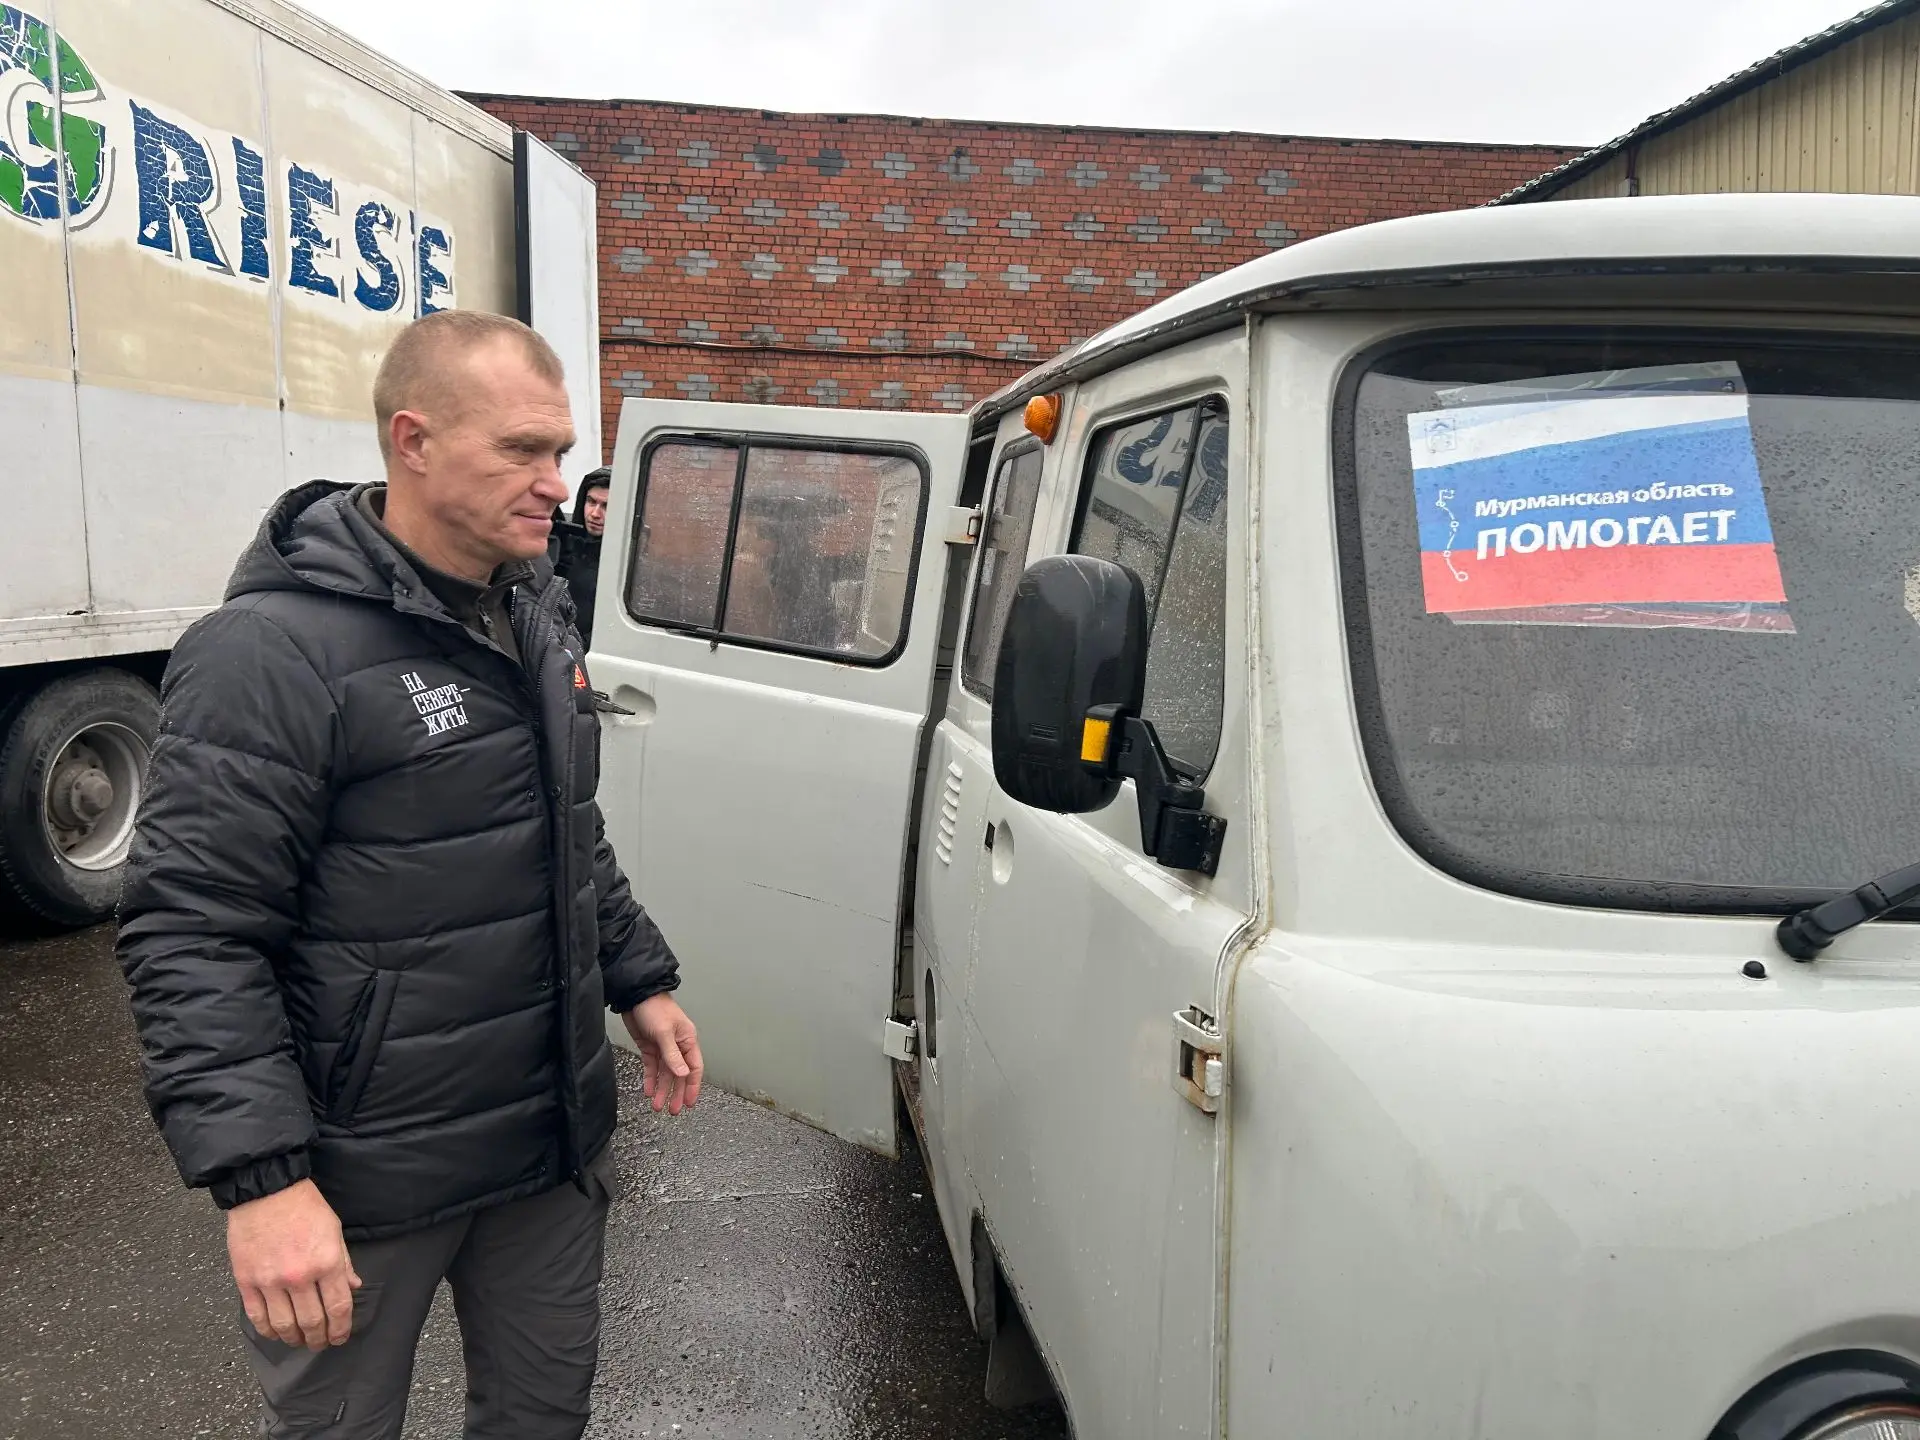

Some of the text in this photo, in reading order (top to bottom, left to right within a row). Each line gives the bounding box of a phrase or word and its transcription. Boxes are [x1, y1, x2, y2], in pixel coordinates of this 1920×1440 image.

[1475, 481, 1734, 518] Мурманская область
[1476, 509, 1736, 561] ПОМОГАЕТ
[400, 671, 427, 694] НА
[421, 704, 469, 737] ЖИТЬ!
